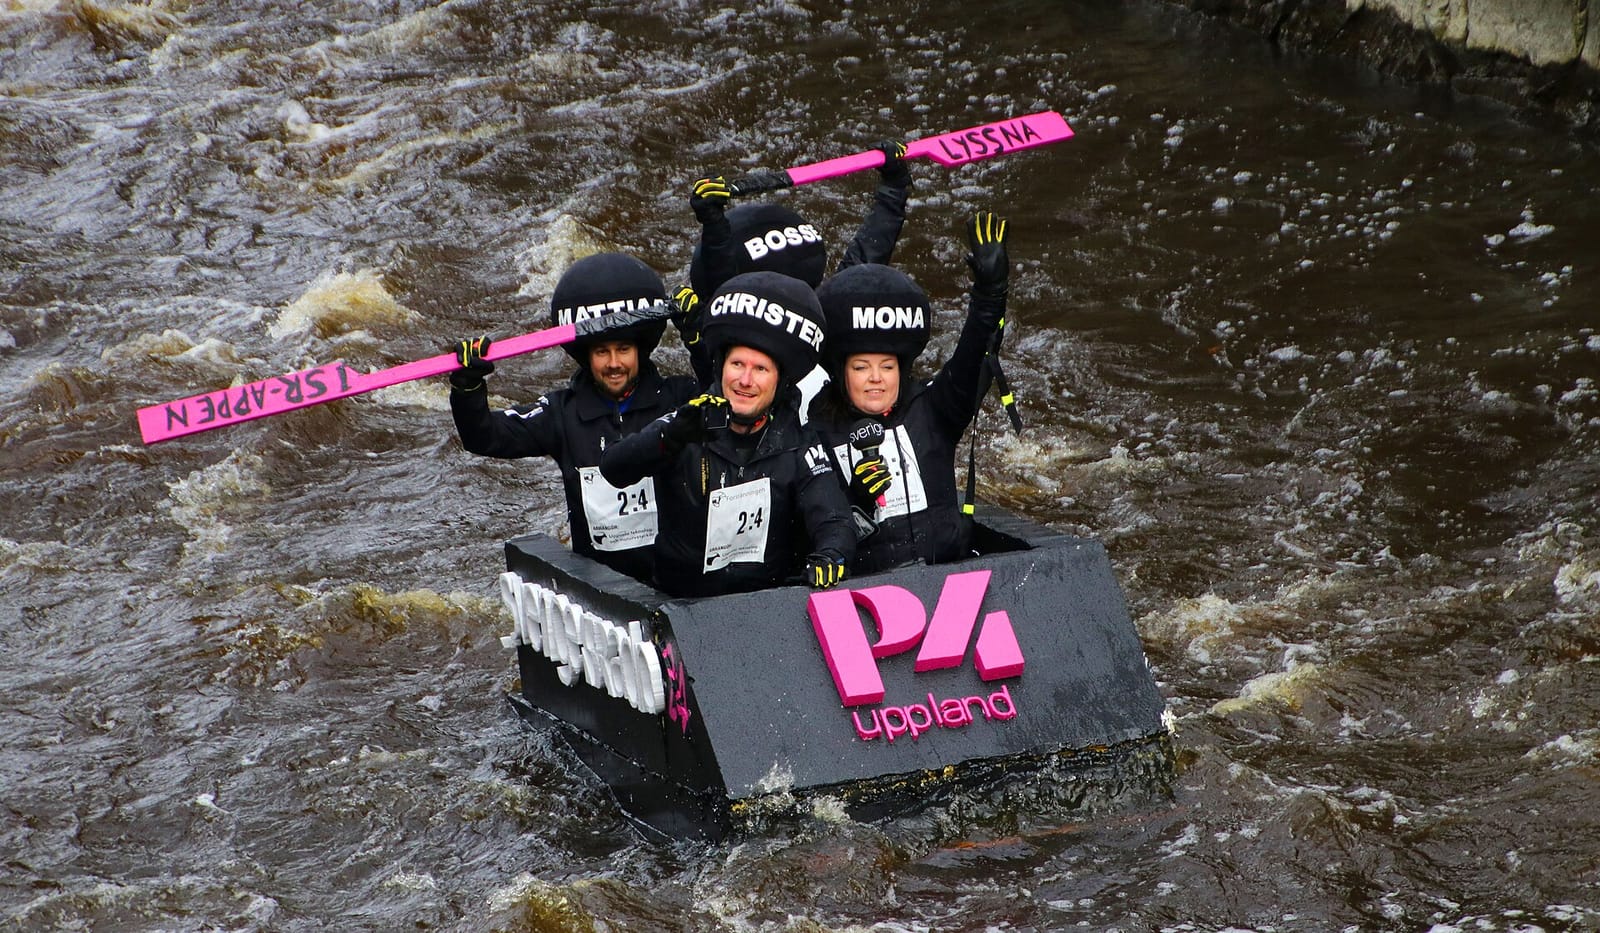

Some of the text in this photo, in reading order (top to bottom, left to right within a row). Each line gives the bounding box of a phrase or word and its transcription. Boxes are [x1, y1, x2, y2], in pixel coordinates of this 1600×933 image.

[938, 121, 1042, 161] LYSSNA
[710, 292, 825, 353] CHRISTER
[852, 306, 924, 329] MONA
[617, 488, 649, 516] 2:4
[736, 507, 763, 535] 2:4
[808, 570, 1025, 707] P4
[852, 685, 1018, 743] uppland
